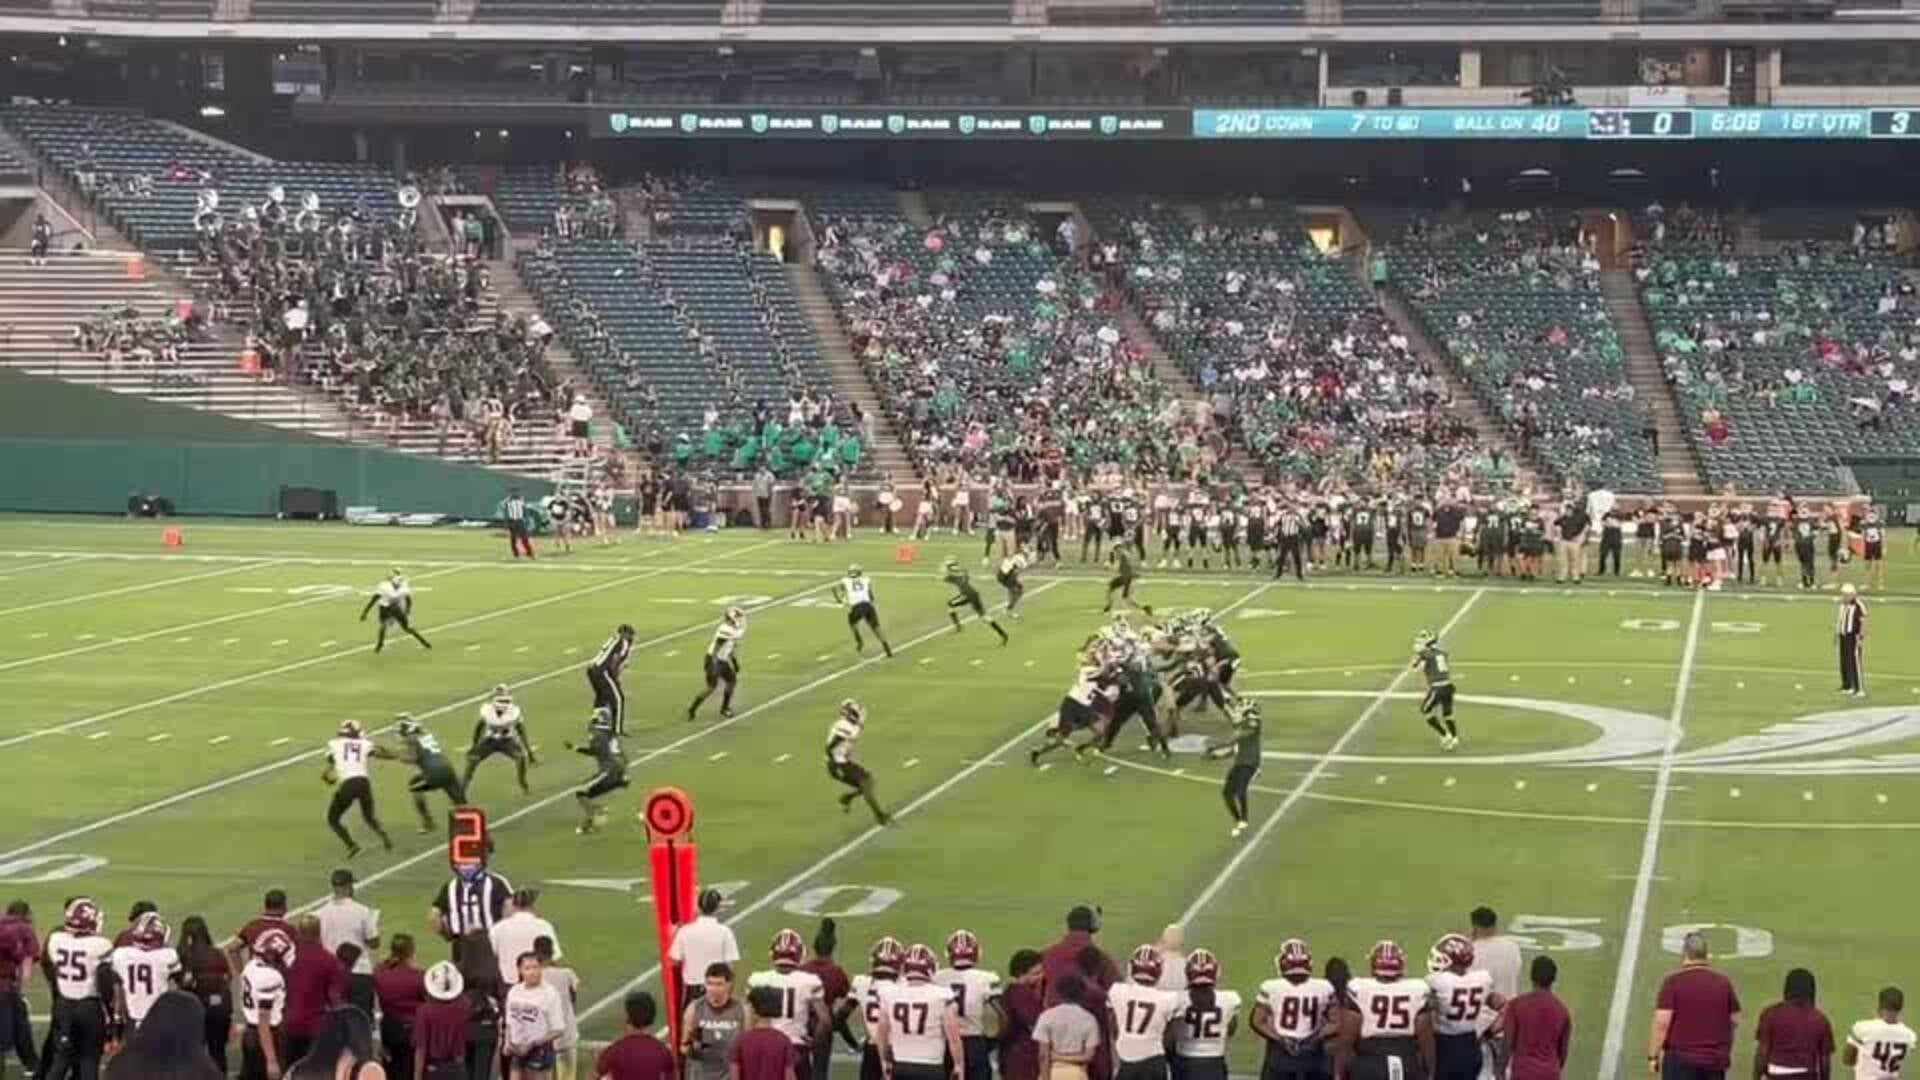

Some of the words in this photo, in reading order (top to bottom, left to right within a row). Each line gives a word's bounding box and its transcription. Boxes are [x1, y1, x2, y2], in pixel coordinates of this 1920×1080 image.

[1215, 113, 1262, 133] 2ND
[1350, 113, 1368, 133] 7
[1530, 112, 1562, 133] 40
[1653, 112, 1674, 134] 0
[1781, 112, 1819, 131] 1ST
[1822, 112, 1863, 133] QTR
[1890, 111, 1911, 133] 3
[342, 741, 362, 763] 14
[453, 811, 482, 864] 2
[56, 948, 88, 982] 25
[128, 963, 154, 995] 19
[892, 1002, 929, 1035] 97
[1125, 999, 1156, 1035] 17
[1279, 995, 1319, 1030] 84
[1371, 994, 1411, 1029] 95
[1446, 987, 1484, 1021] 55
[1184, 1007, 1222, 1039] 92
[1871, 1040, 1908, 1073] 42
